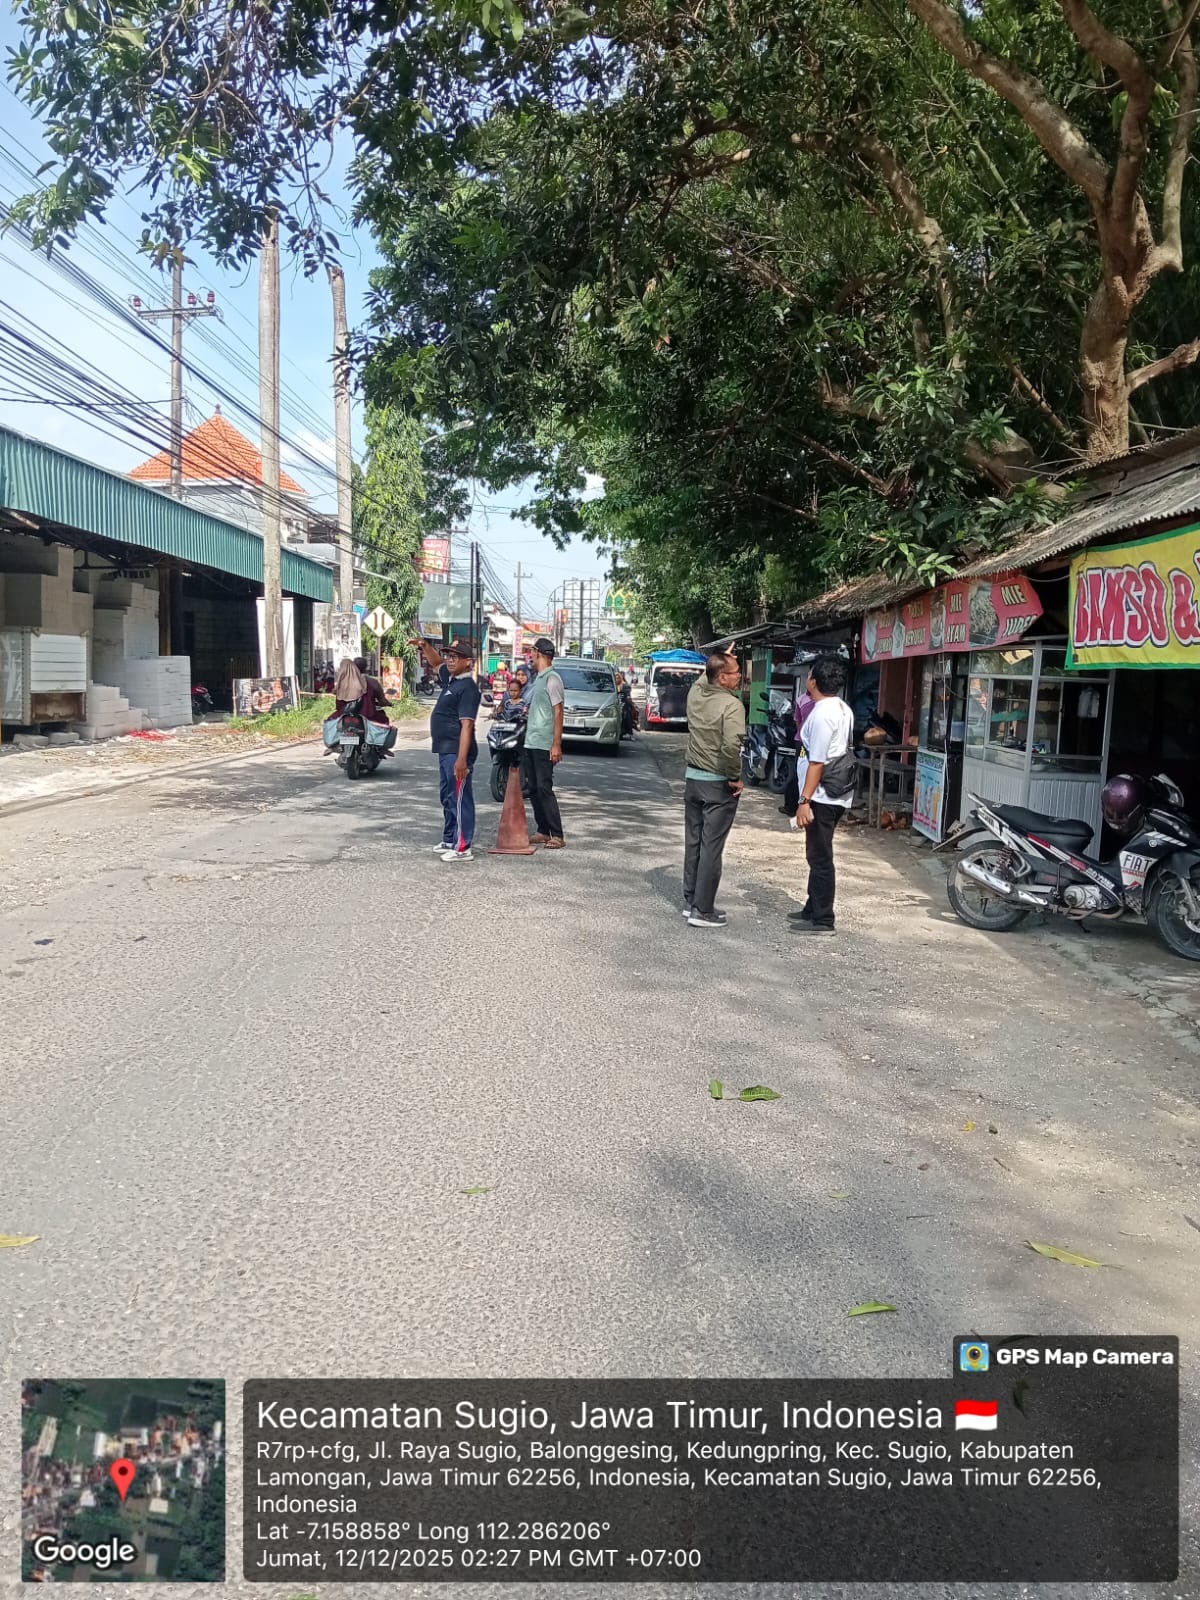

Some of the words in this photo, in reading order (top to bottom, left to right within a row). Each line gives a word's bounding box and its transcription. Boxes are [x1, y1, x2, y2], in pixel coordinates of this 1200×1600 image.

[1001, 584, 1027, 606] MIE
[946, 623, 967, 644] AYAM
[1123, 854, 1153, 871] FIAT
